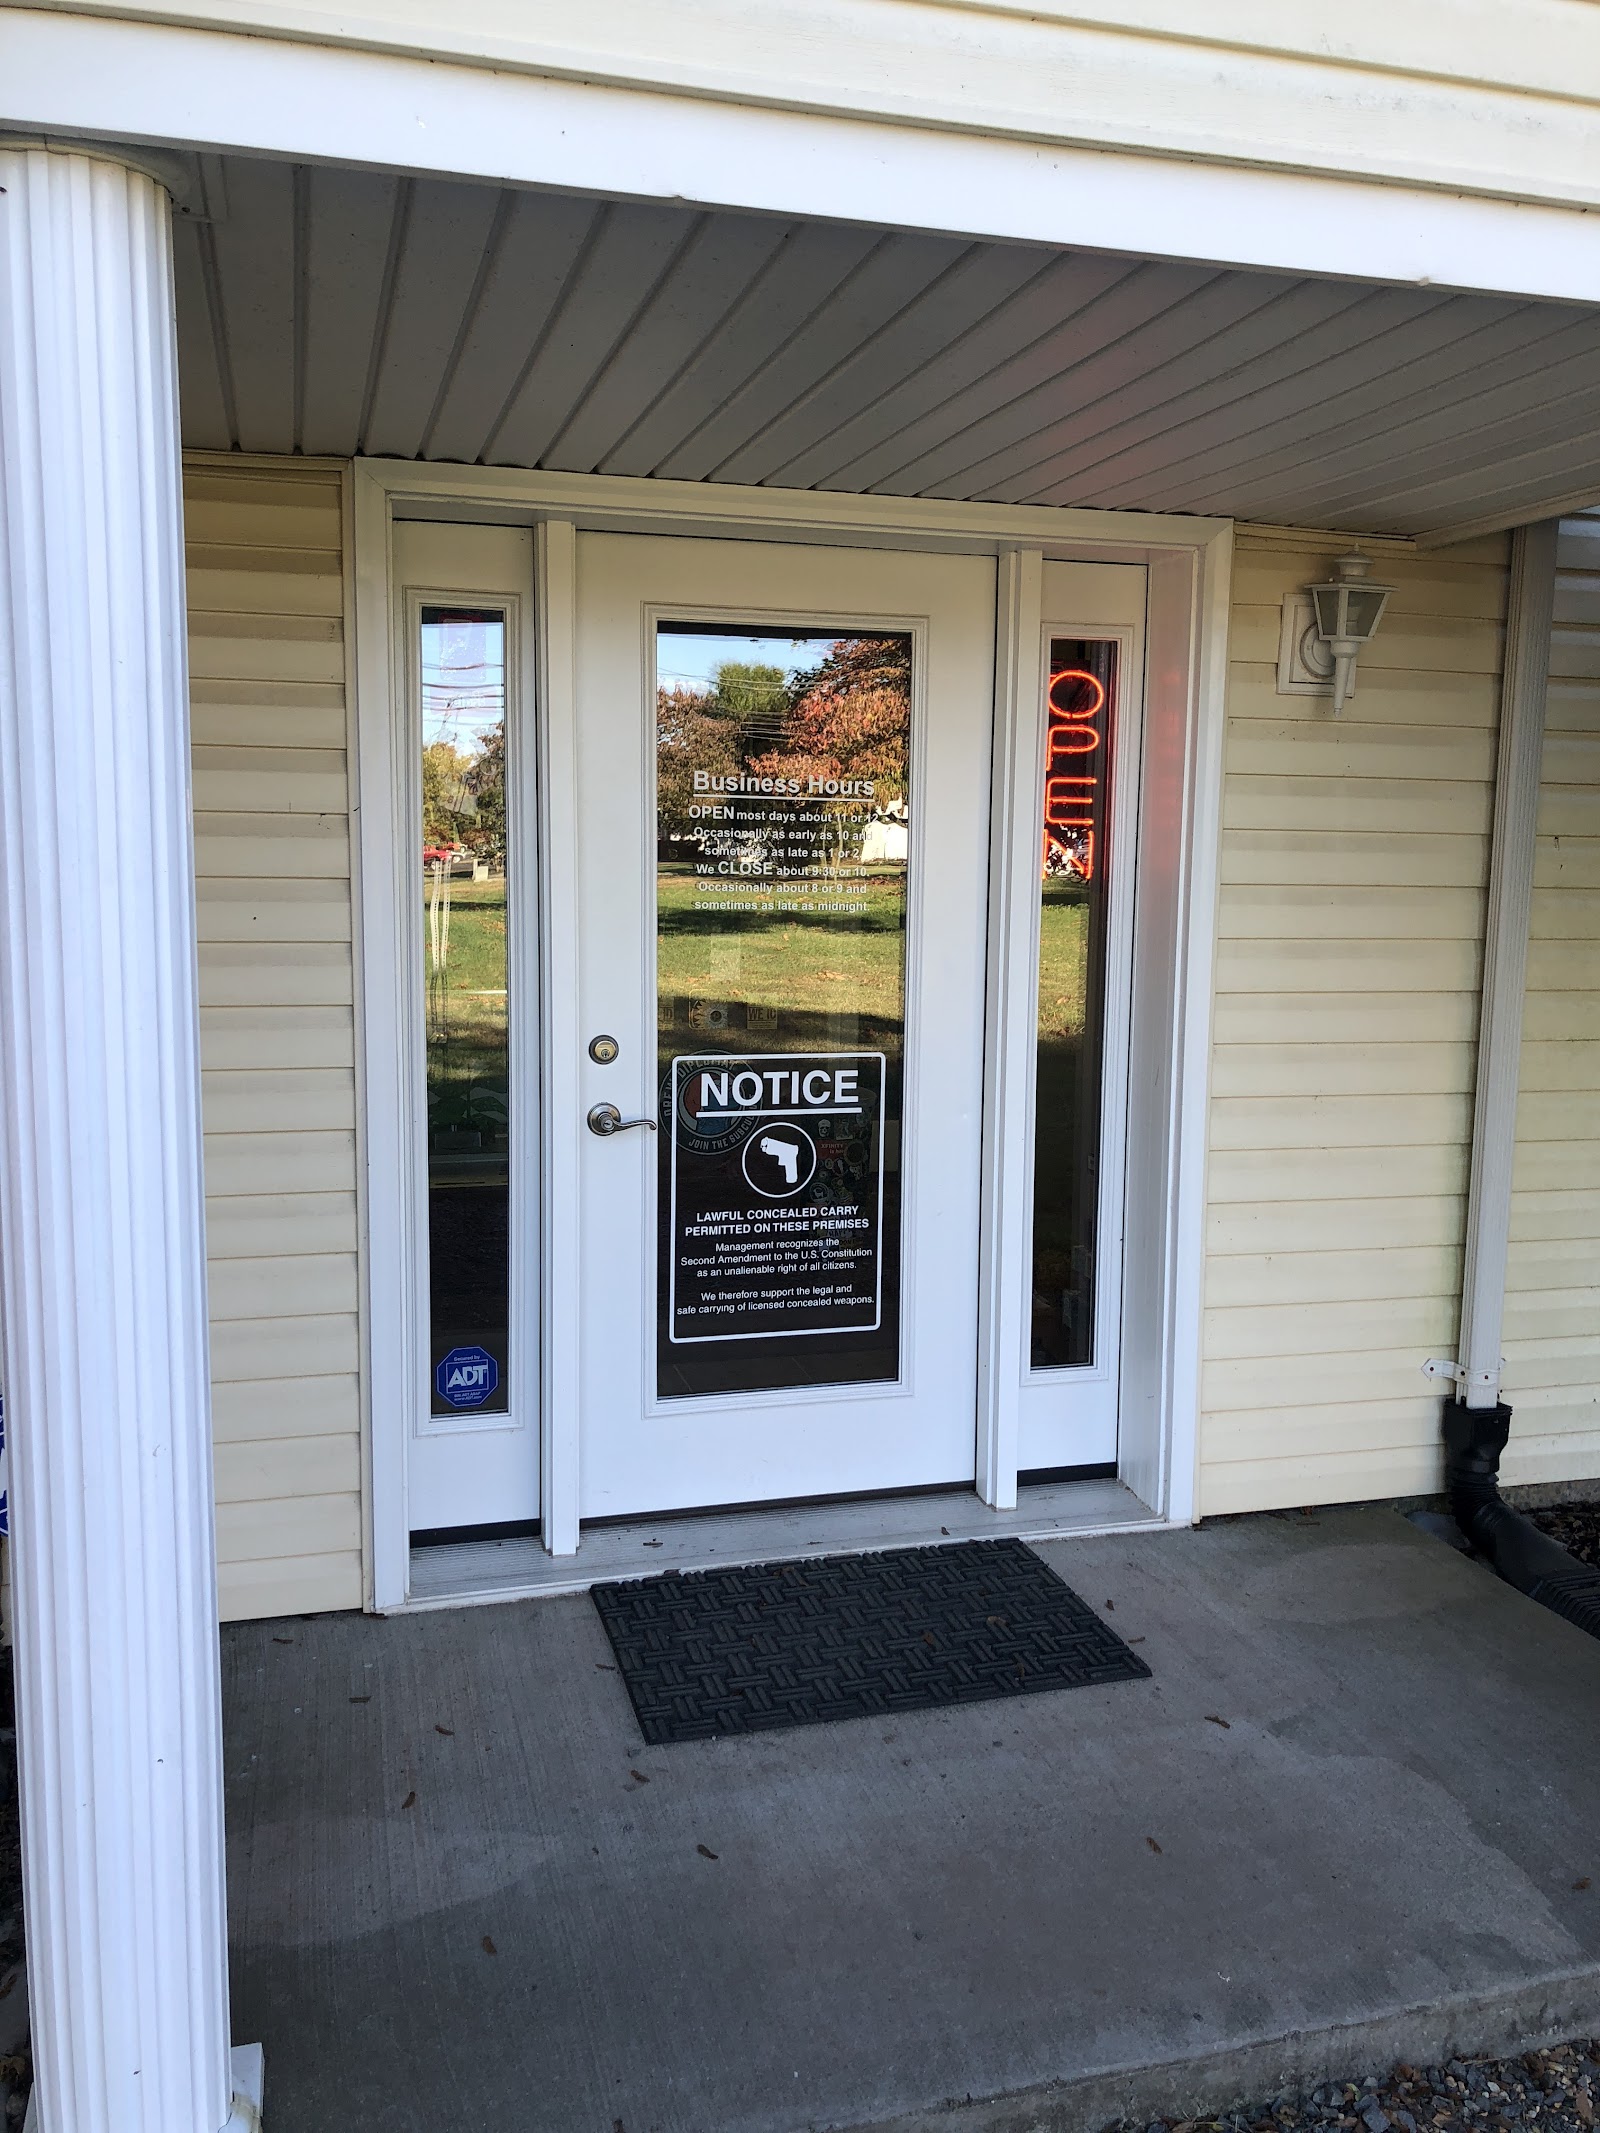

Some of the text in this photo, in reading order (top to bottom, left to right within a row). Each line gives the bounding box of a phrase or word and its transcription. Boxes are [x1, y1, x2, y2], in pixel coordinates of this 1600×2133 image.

[693, 770, 875, 796] Business Hours
[1042, 670, 1104, 880] OPEN
[688, 806, 734, 820] OPEN
[737, 810, 766, 821] most
[769, 811, 796, 822] days
[800, 812, 832, 822] about
[836, 814, 848, 822] 11
[694, 826, 872, 842] Occasionally as early as 10 and
[704, 846, 768, 857] sometimes
[771, 848, 784, 858] as
[788, 848, 808, 858] late
[812, 849, 824, 858] as
[828, 848, 834, 858] 1
[838, 850, 850, 858] or
[696, 864, 714, 874] We
[718, 861, 773, 875] CLOSE
[776, 866, 808, 876] about
[812, 866, 835, 876] 9:30
[854, 867, 870, 877] 10.
[698, 882, 866, 894] Occasionally about 8 or 9 and
[694, 900, 870, 913] sometimes as late as midnight.
[700, 1070, 859, 1107] NOTICE
[688, 1138, 709, 1150] JOIN
[712, 1138, 729, 1150] THE
[696, 1206, 859, 1222] LAWFUL CONCEALED CARRY
[685, 1218, 870, 1236] PERMITTED ON THESE PREMISES
[716, 1242, 774, 1255] Management
[776, 1239, 823, 1252] recognizes
[826, 1238, 839, 1247] the
[680, 1248, 872, 1266] Second Amendment to the U.S. Constitution
[697, 1260, 857, 1277] as an unalienable right of all citizens.
[701, 1284, 852, 1301] We therefore support the legal and
[677, 1296, 874, 1315] safe carrying of licensed concealed weapons.
[448, 1364, 488, 1388] ADT
